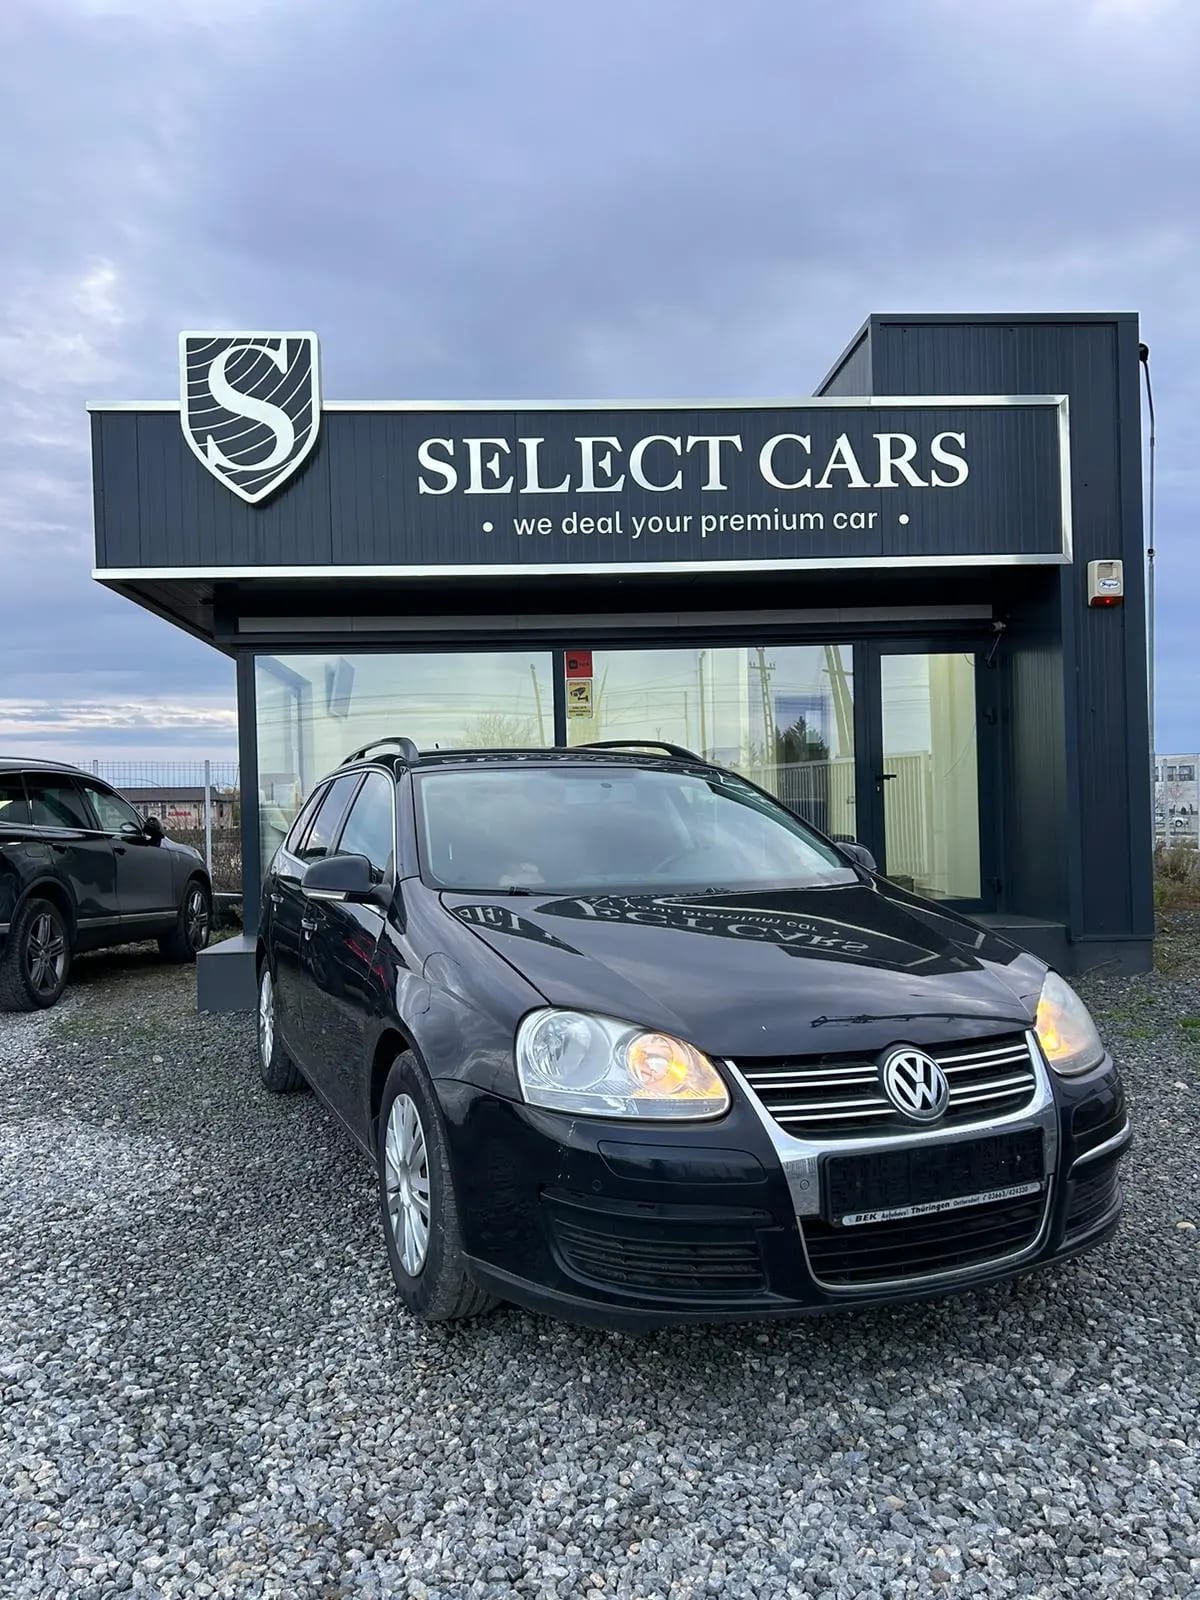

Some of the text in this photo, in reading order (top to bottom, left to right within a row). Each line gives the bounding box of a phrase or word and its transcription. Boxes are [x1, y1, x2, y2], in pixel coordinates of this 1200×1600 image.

[206, 337, 295, 471] S
[418, 431, 969, 495] SELECT CARS
[514, 507, 879, 538] we deal your premium car
[886, 1051, 946, 1117] VW
[855, 1213, 878, 1223] BEK
[911, 1202, 951, 1215] Thüringen
